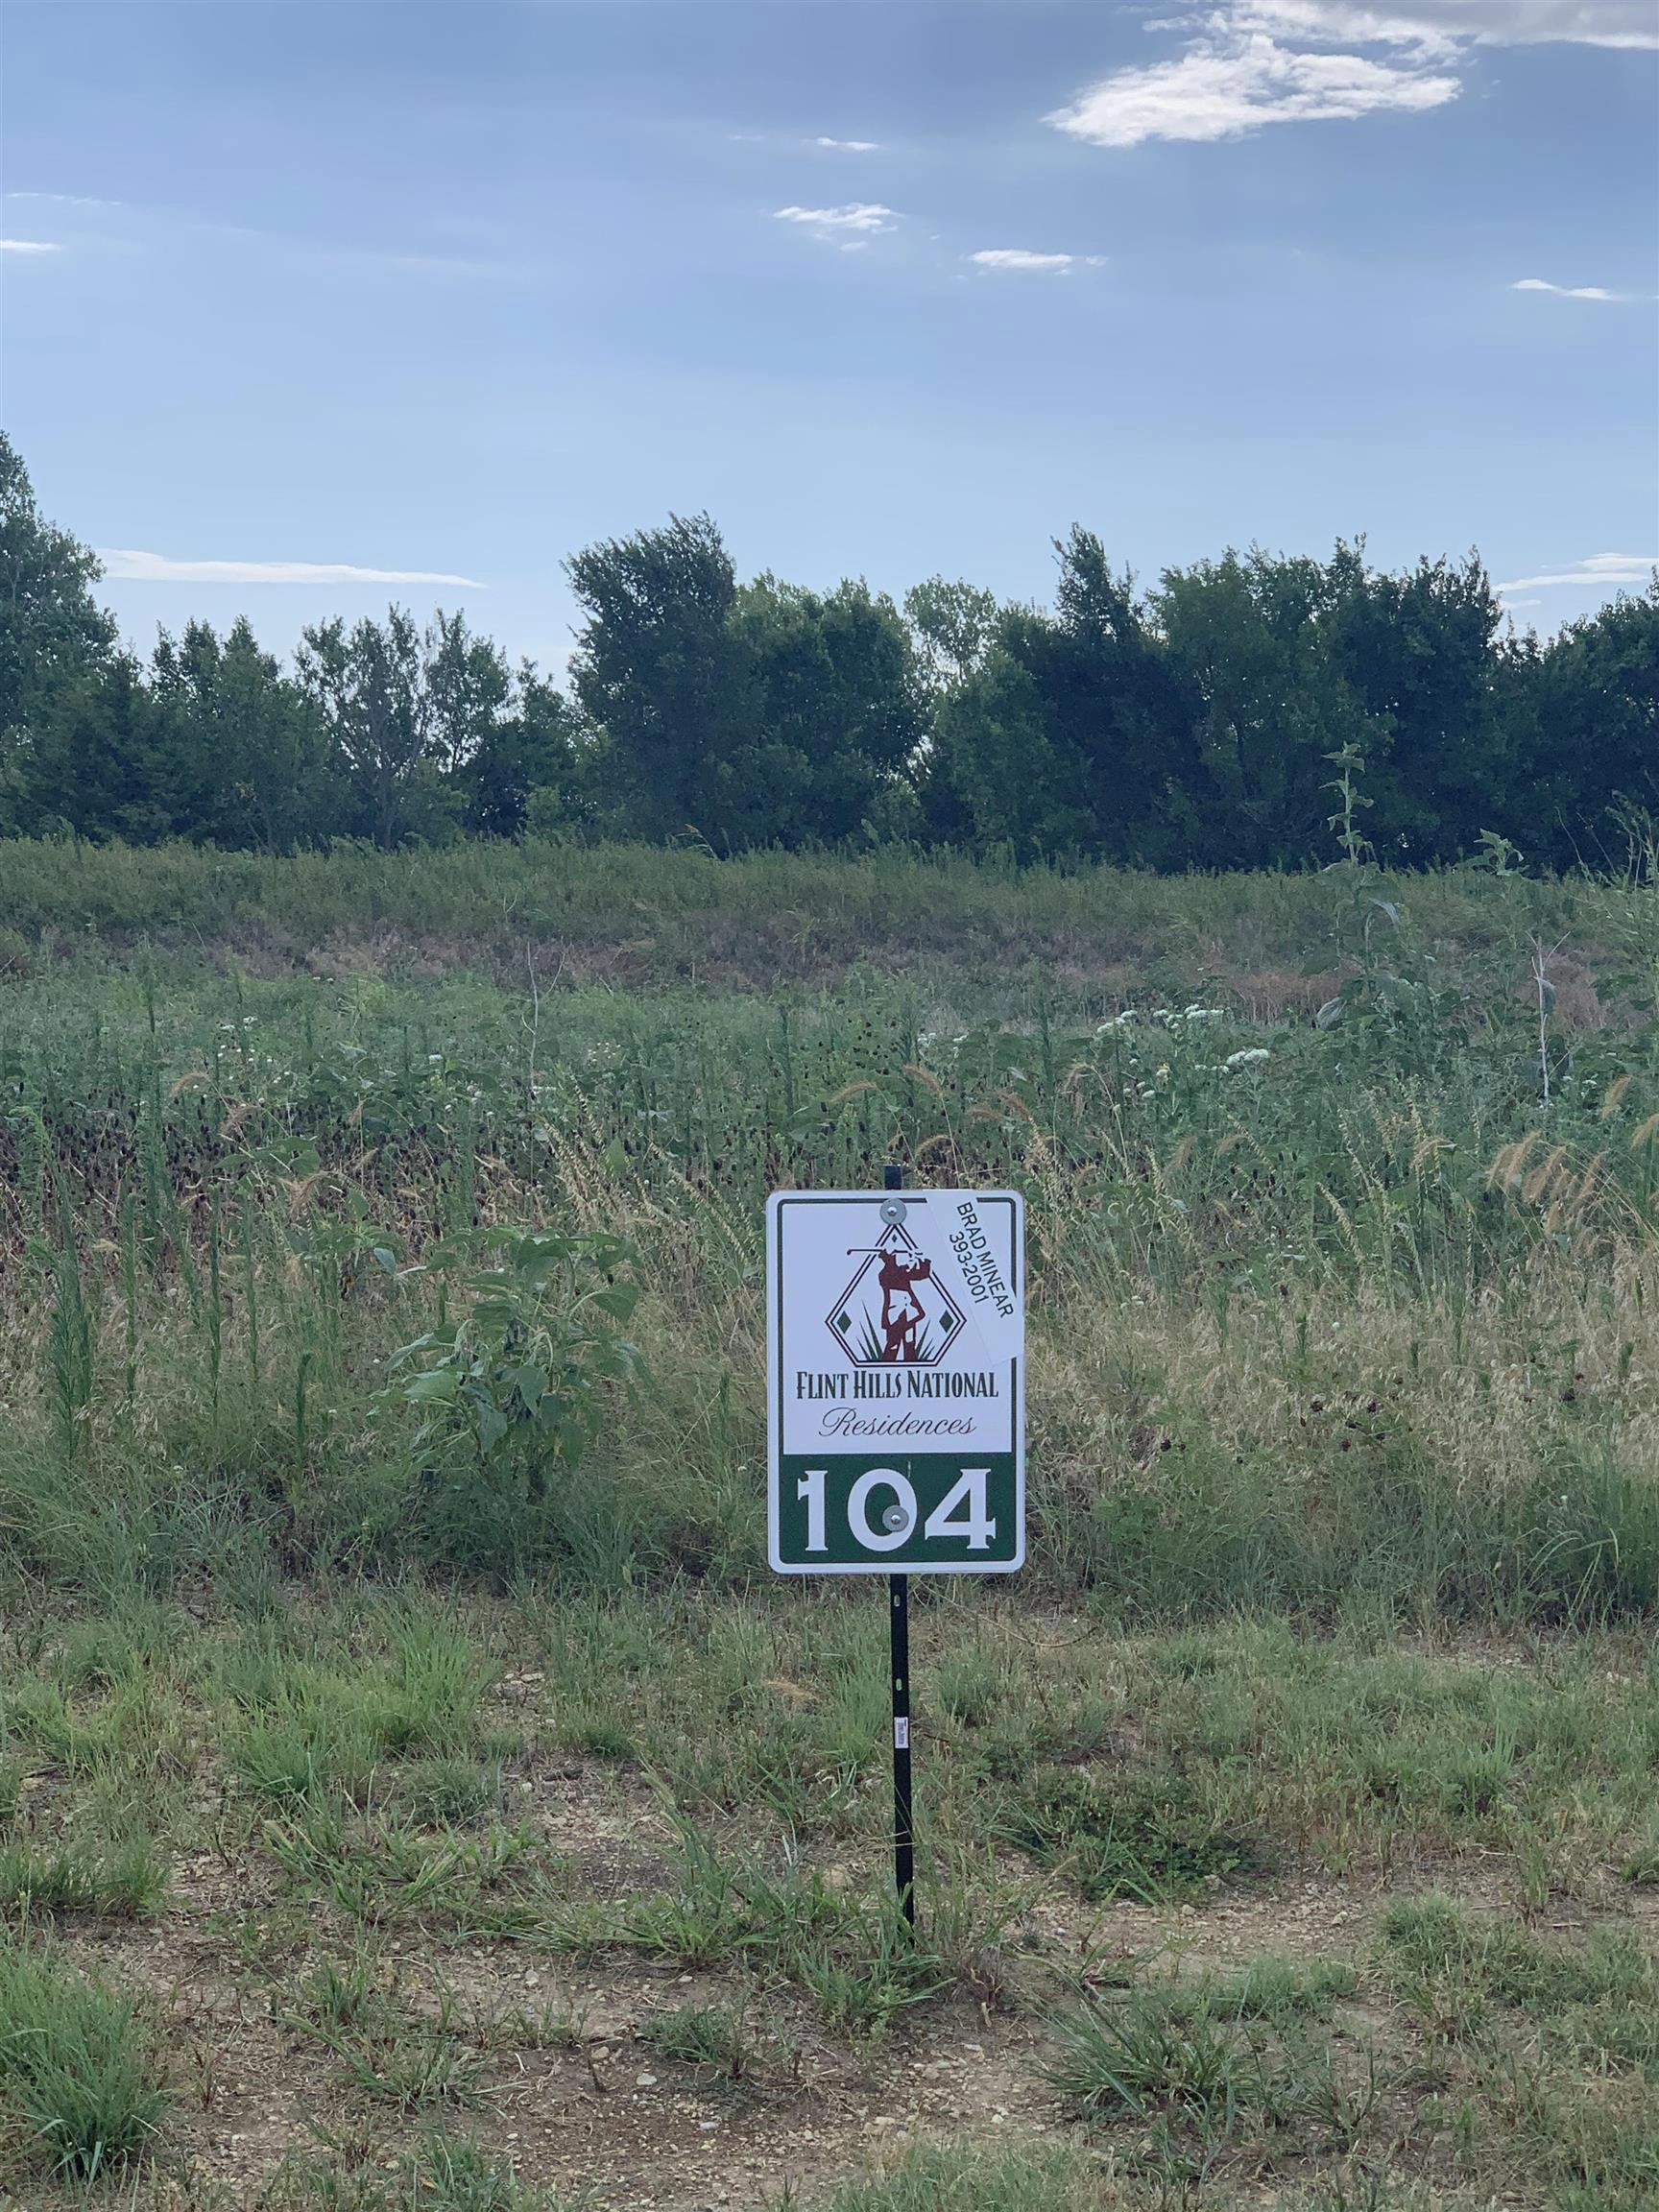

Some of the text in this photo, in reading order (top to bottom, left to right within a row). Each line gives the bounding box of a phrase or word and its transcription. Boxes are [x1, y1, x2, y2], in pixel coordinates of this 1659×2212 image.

[949, 1232, 990, 1304] 393-2001
[956, 1201, 1014, 1318] BRAD MINEAR
[796, 1370, 999, 1400] FLINT HILLS NATIONAL
[818, 1407, 977, 1437] Residences
[797, 1468, 997, 1552] 104
